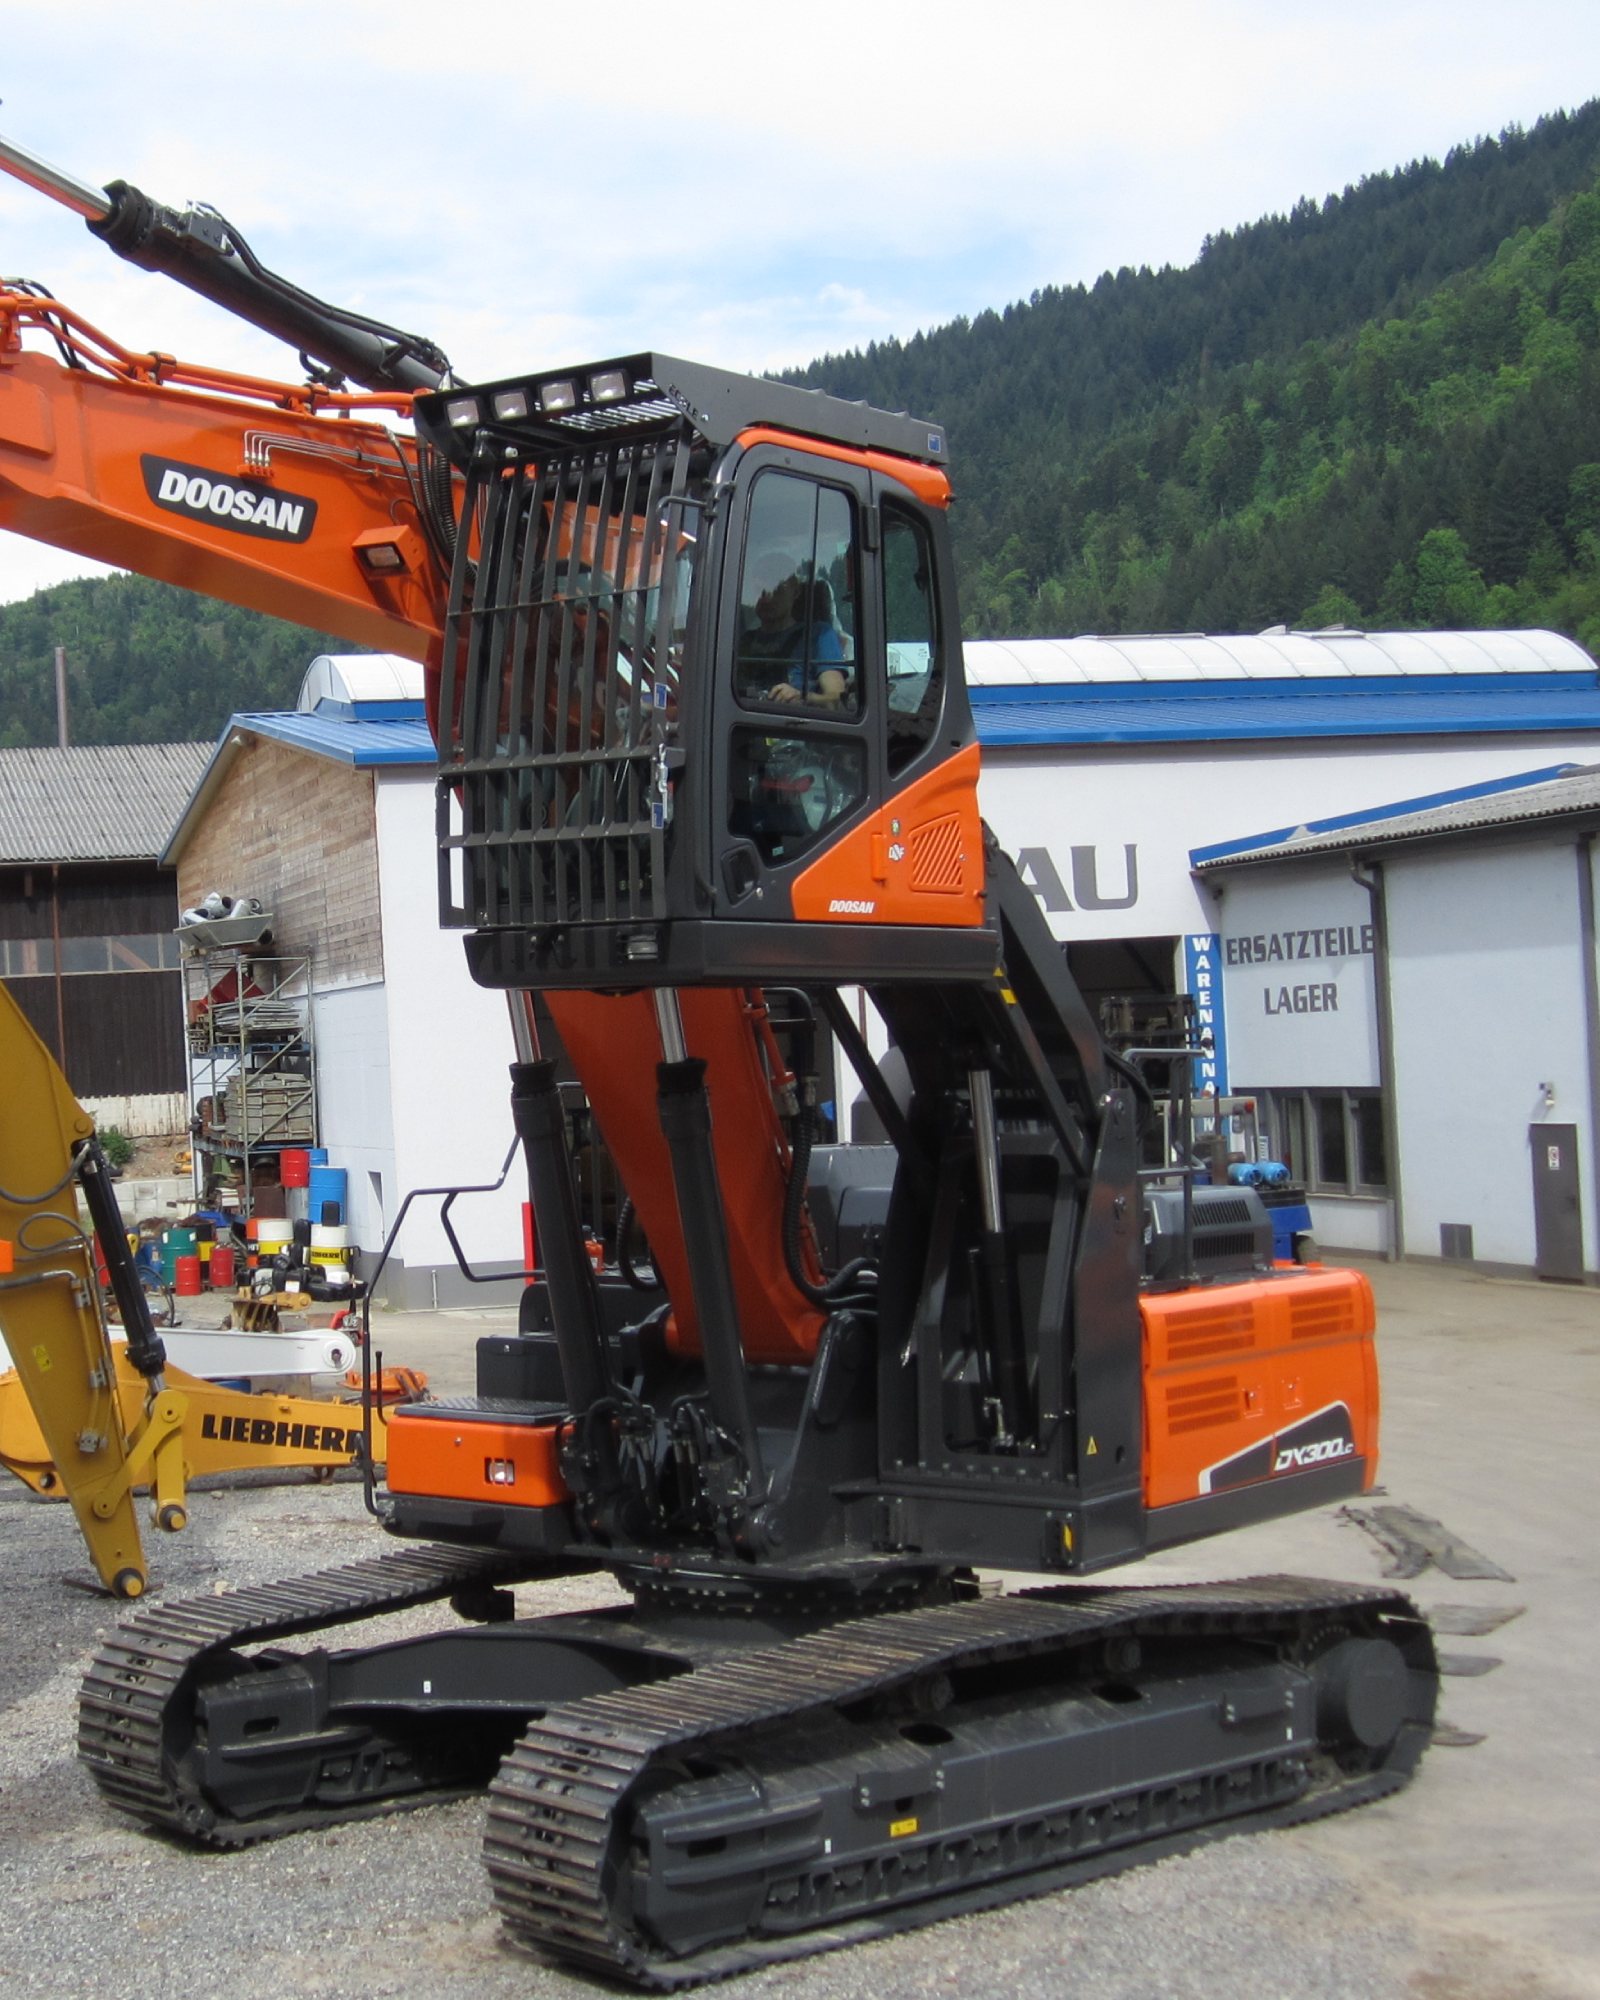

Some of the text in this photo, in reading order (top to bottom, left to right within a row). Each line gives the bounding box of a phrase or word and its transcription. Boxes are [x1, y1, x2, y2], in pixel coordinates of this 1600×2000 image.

[158, 469, 304, 534] DOOSAN
[828, 900, 875, 914] DOOSAN
[1226, 924, 1375, 966] ERSATZTEILE
[1264, 982, 1338, 1015] LAGER
